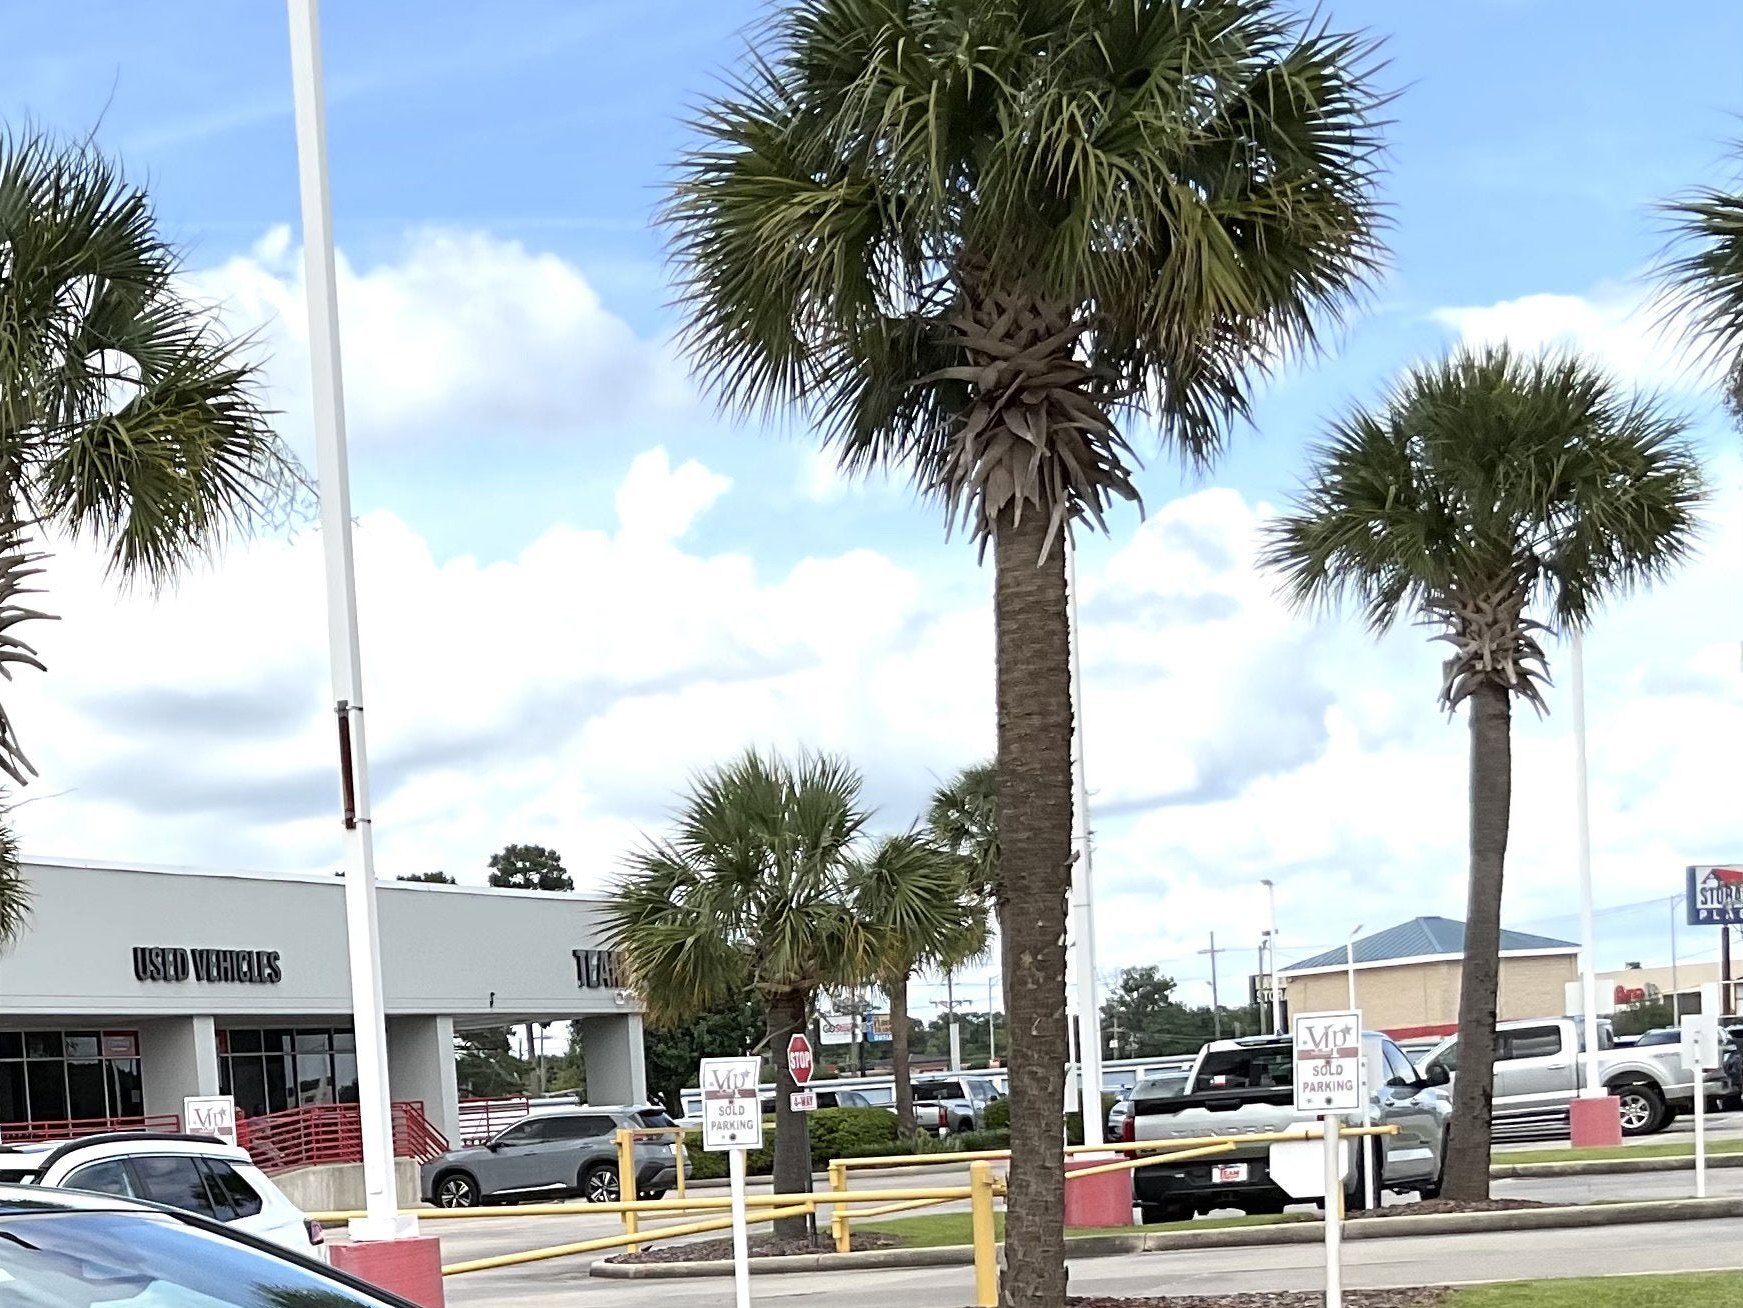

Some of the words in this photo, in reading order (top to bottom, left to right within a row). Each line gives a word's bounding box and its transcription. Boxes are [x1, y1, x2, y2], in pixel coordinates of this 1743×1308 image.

[133, 947, 189, 981] USED
[190, 948, 282, 983] VEHICLES
[790, 1051, 810, 1069] STOP
[1312, 1063, 1344, 1077] SOLD
[1303, 1079, 1354, 1093] PARKING
[718, 1105, 746, 1117] SOLD
[711, 1120, 754, 1131] PARKING
